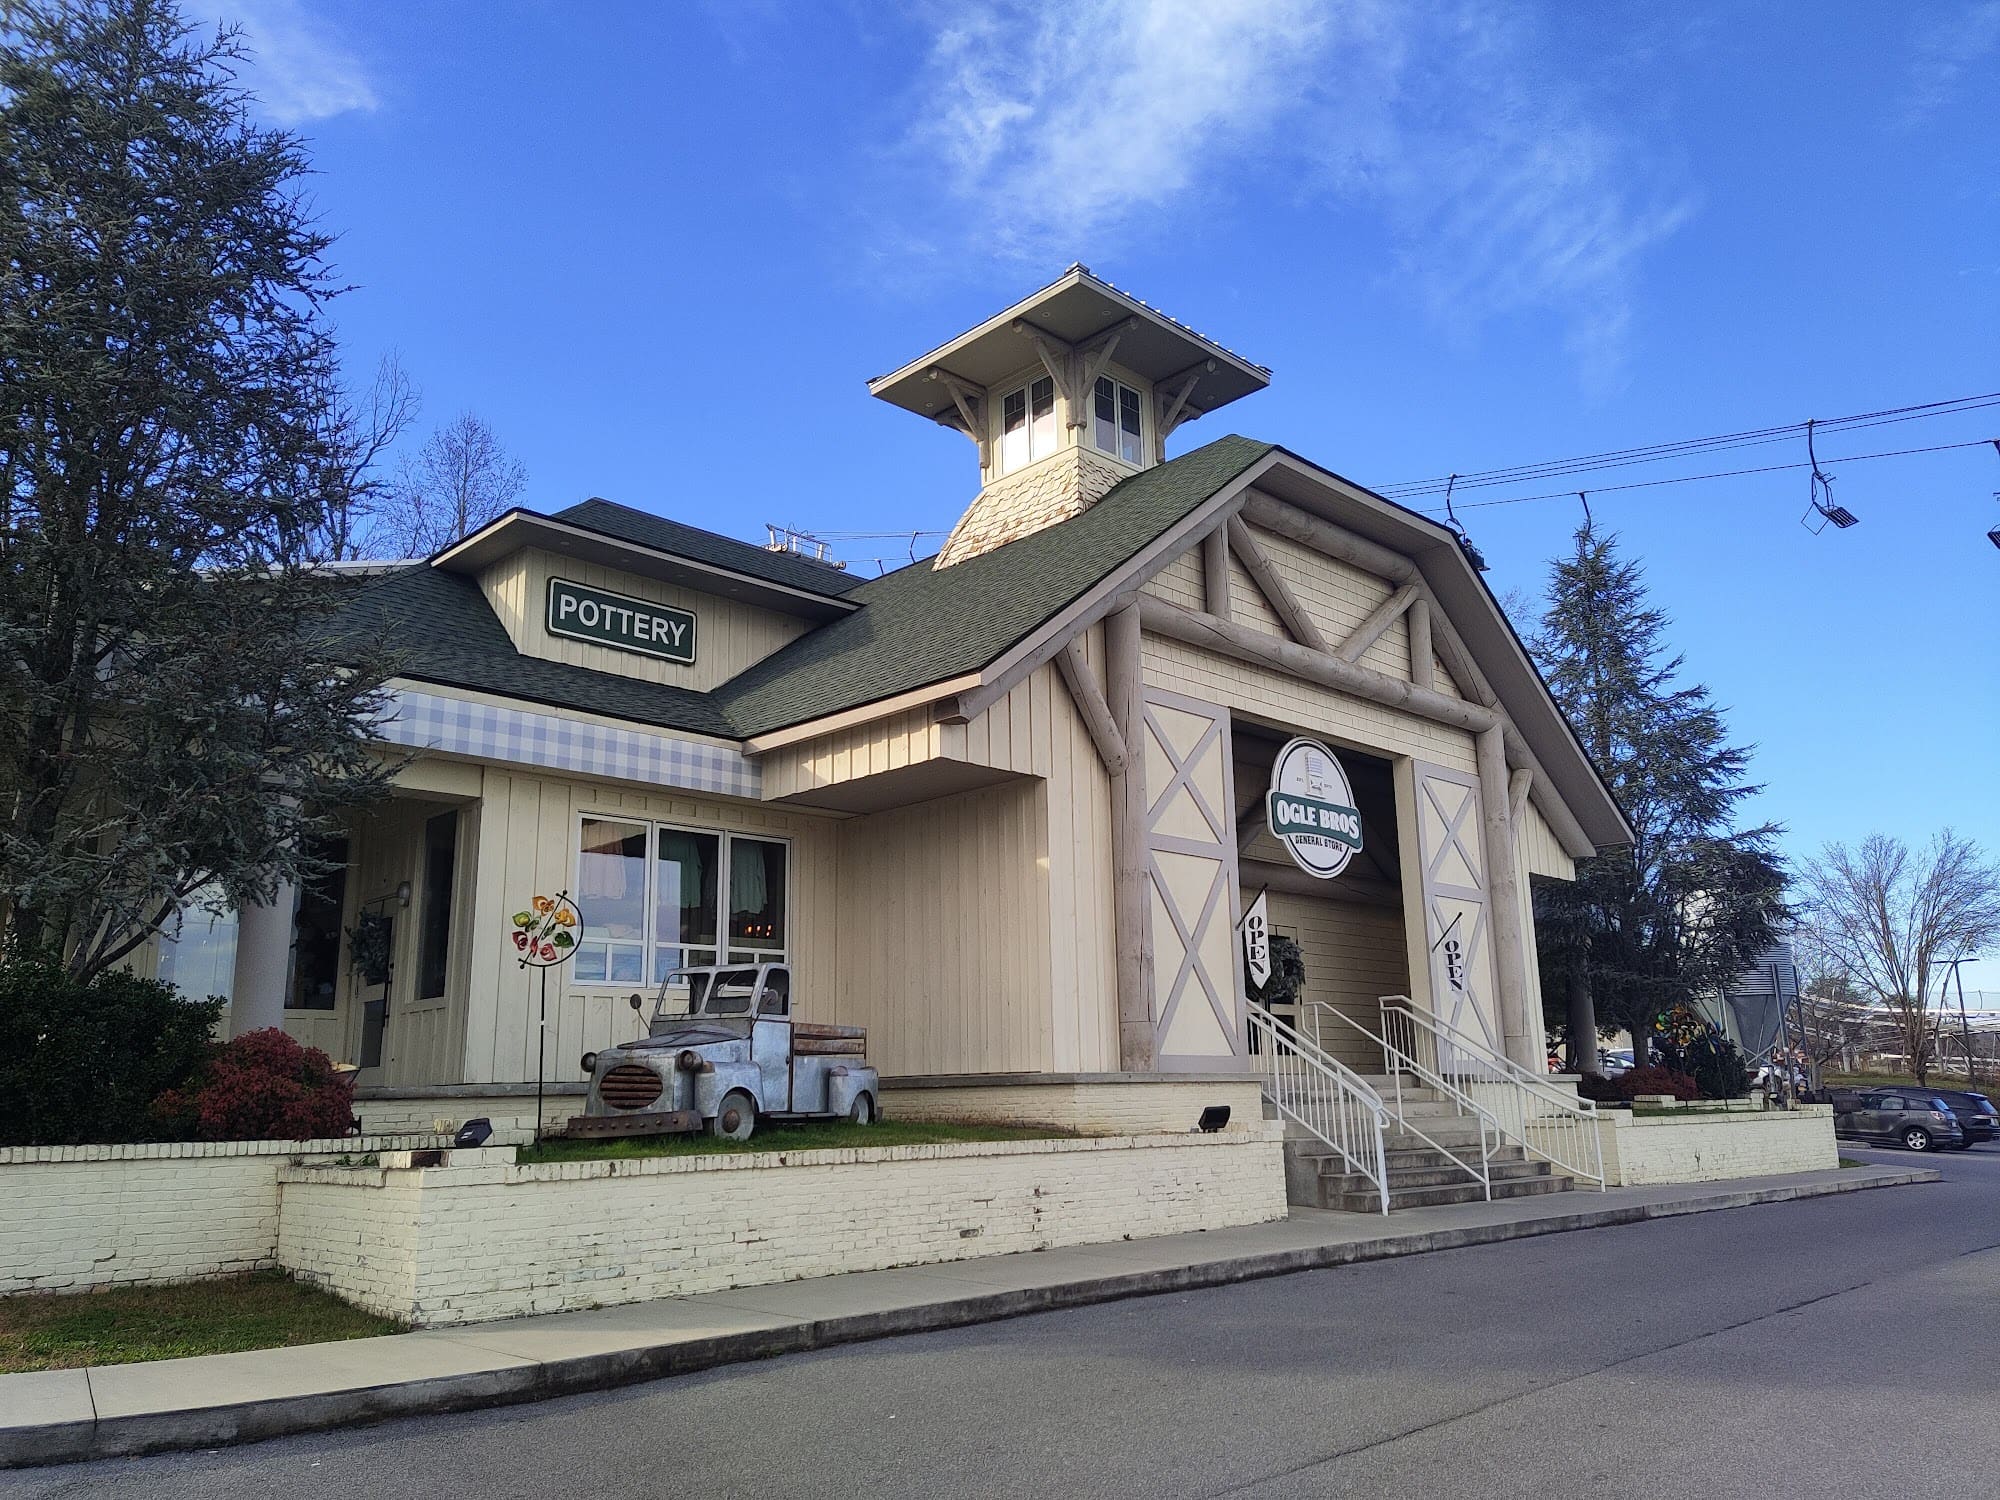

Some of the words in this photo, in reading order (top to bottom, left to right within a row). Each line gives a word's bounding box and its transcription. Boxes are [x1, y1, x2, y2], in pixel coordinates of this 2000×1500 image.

[559, 593, 687, 647] POTTERY
[1277, 800, 1318, 827] OGLE
[1319, 809, 1360, 840] BROS
[1295, 835, 1323, 847] GENERAL
[1324, 838, 1344, 853] STORE
[1248, 916, 1265, 975] OPEN
[1444, 940, 1463, 991] OPEN
